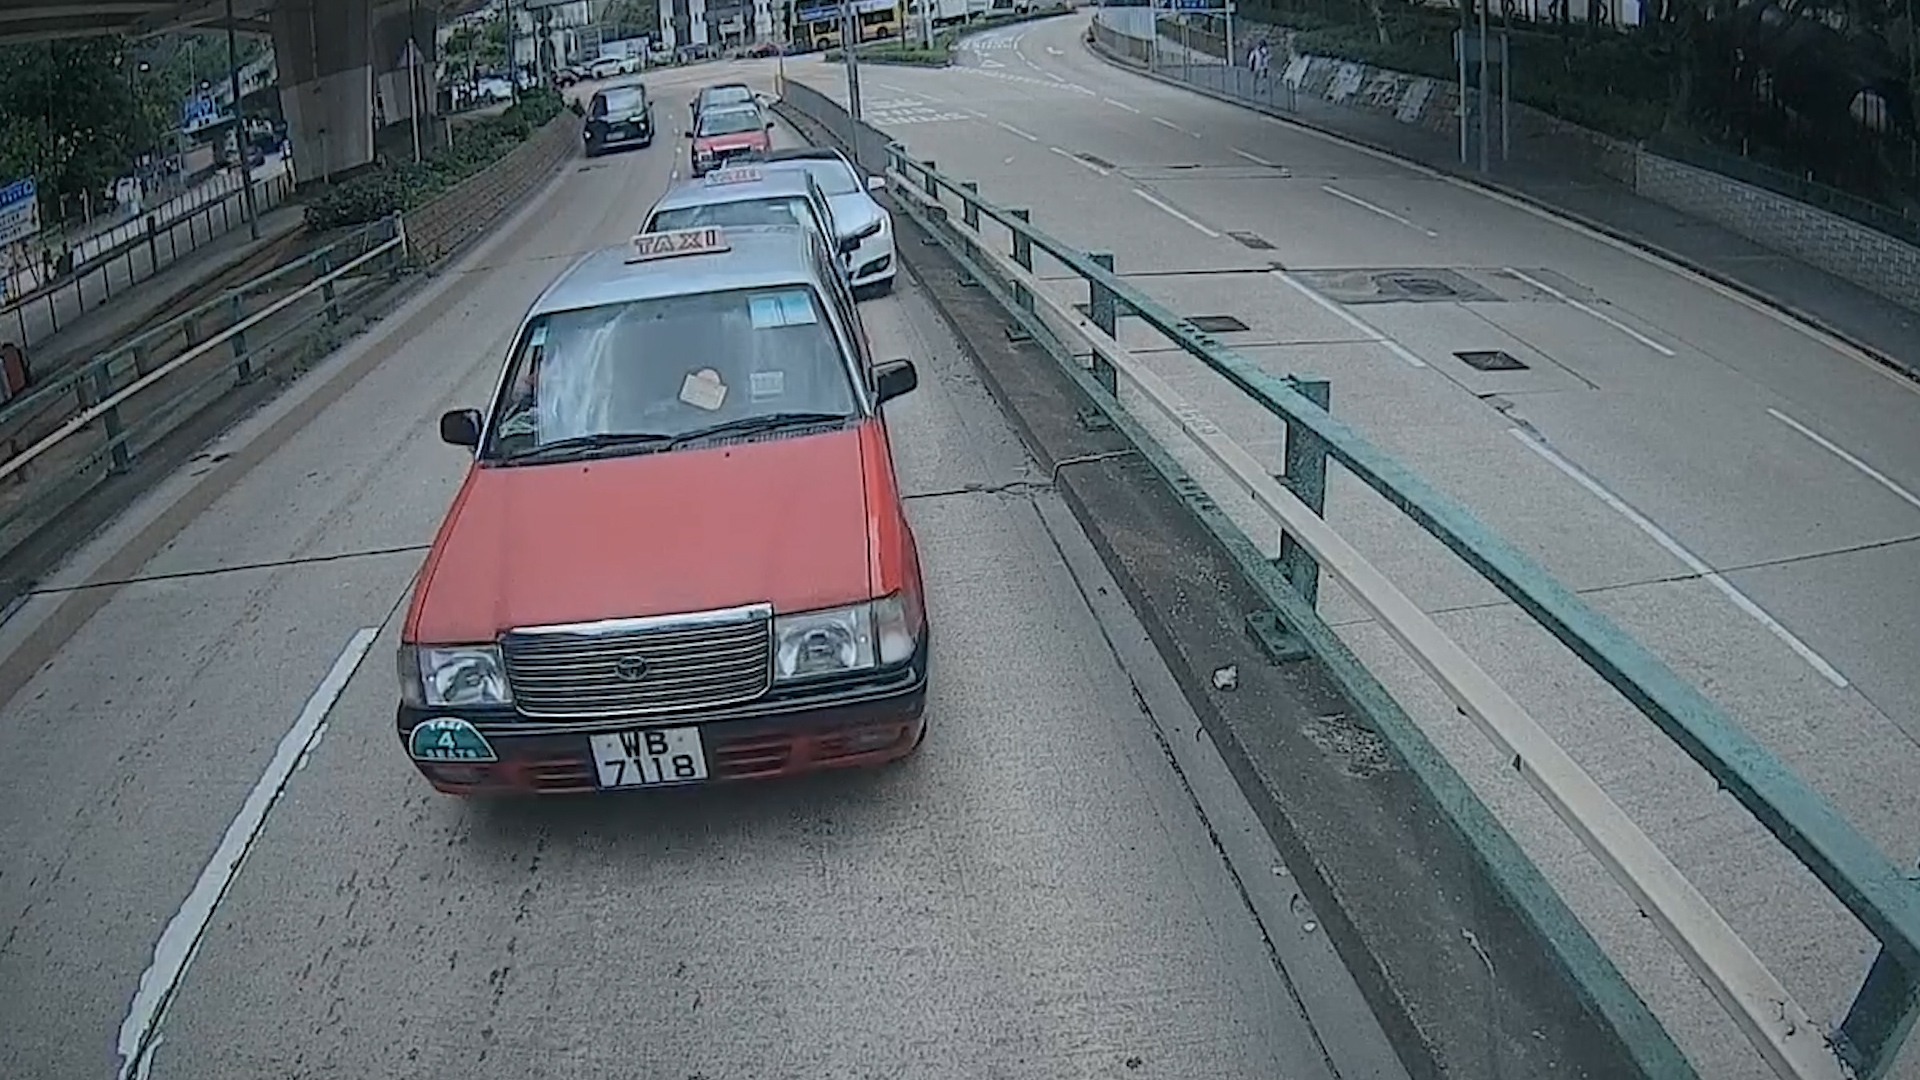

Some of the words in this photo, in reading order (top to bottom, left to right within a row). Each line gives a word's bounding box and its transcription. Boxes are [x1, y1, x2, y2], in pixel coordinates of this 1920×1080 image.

[634, 230, 716, 255] TAXI
[437, 731, 456, 749] 4
[619, 731, 669, 757] WB
[604, 754, 696, 785] 7118
